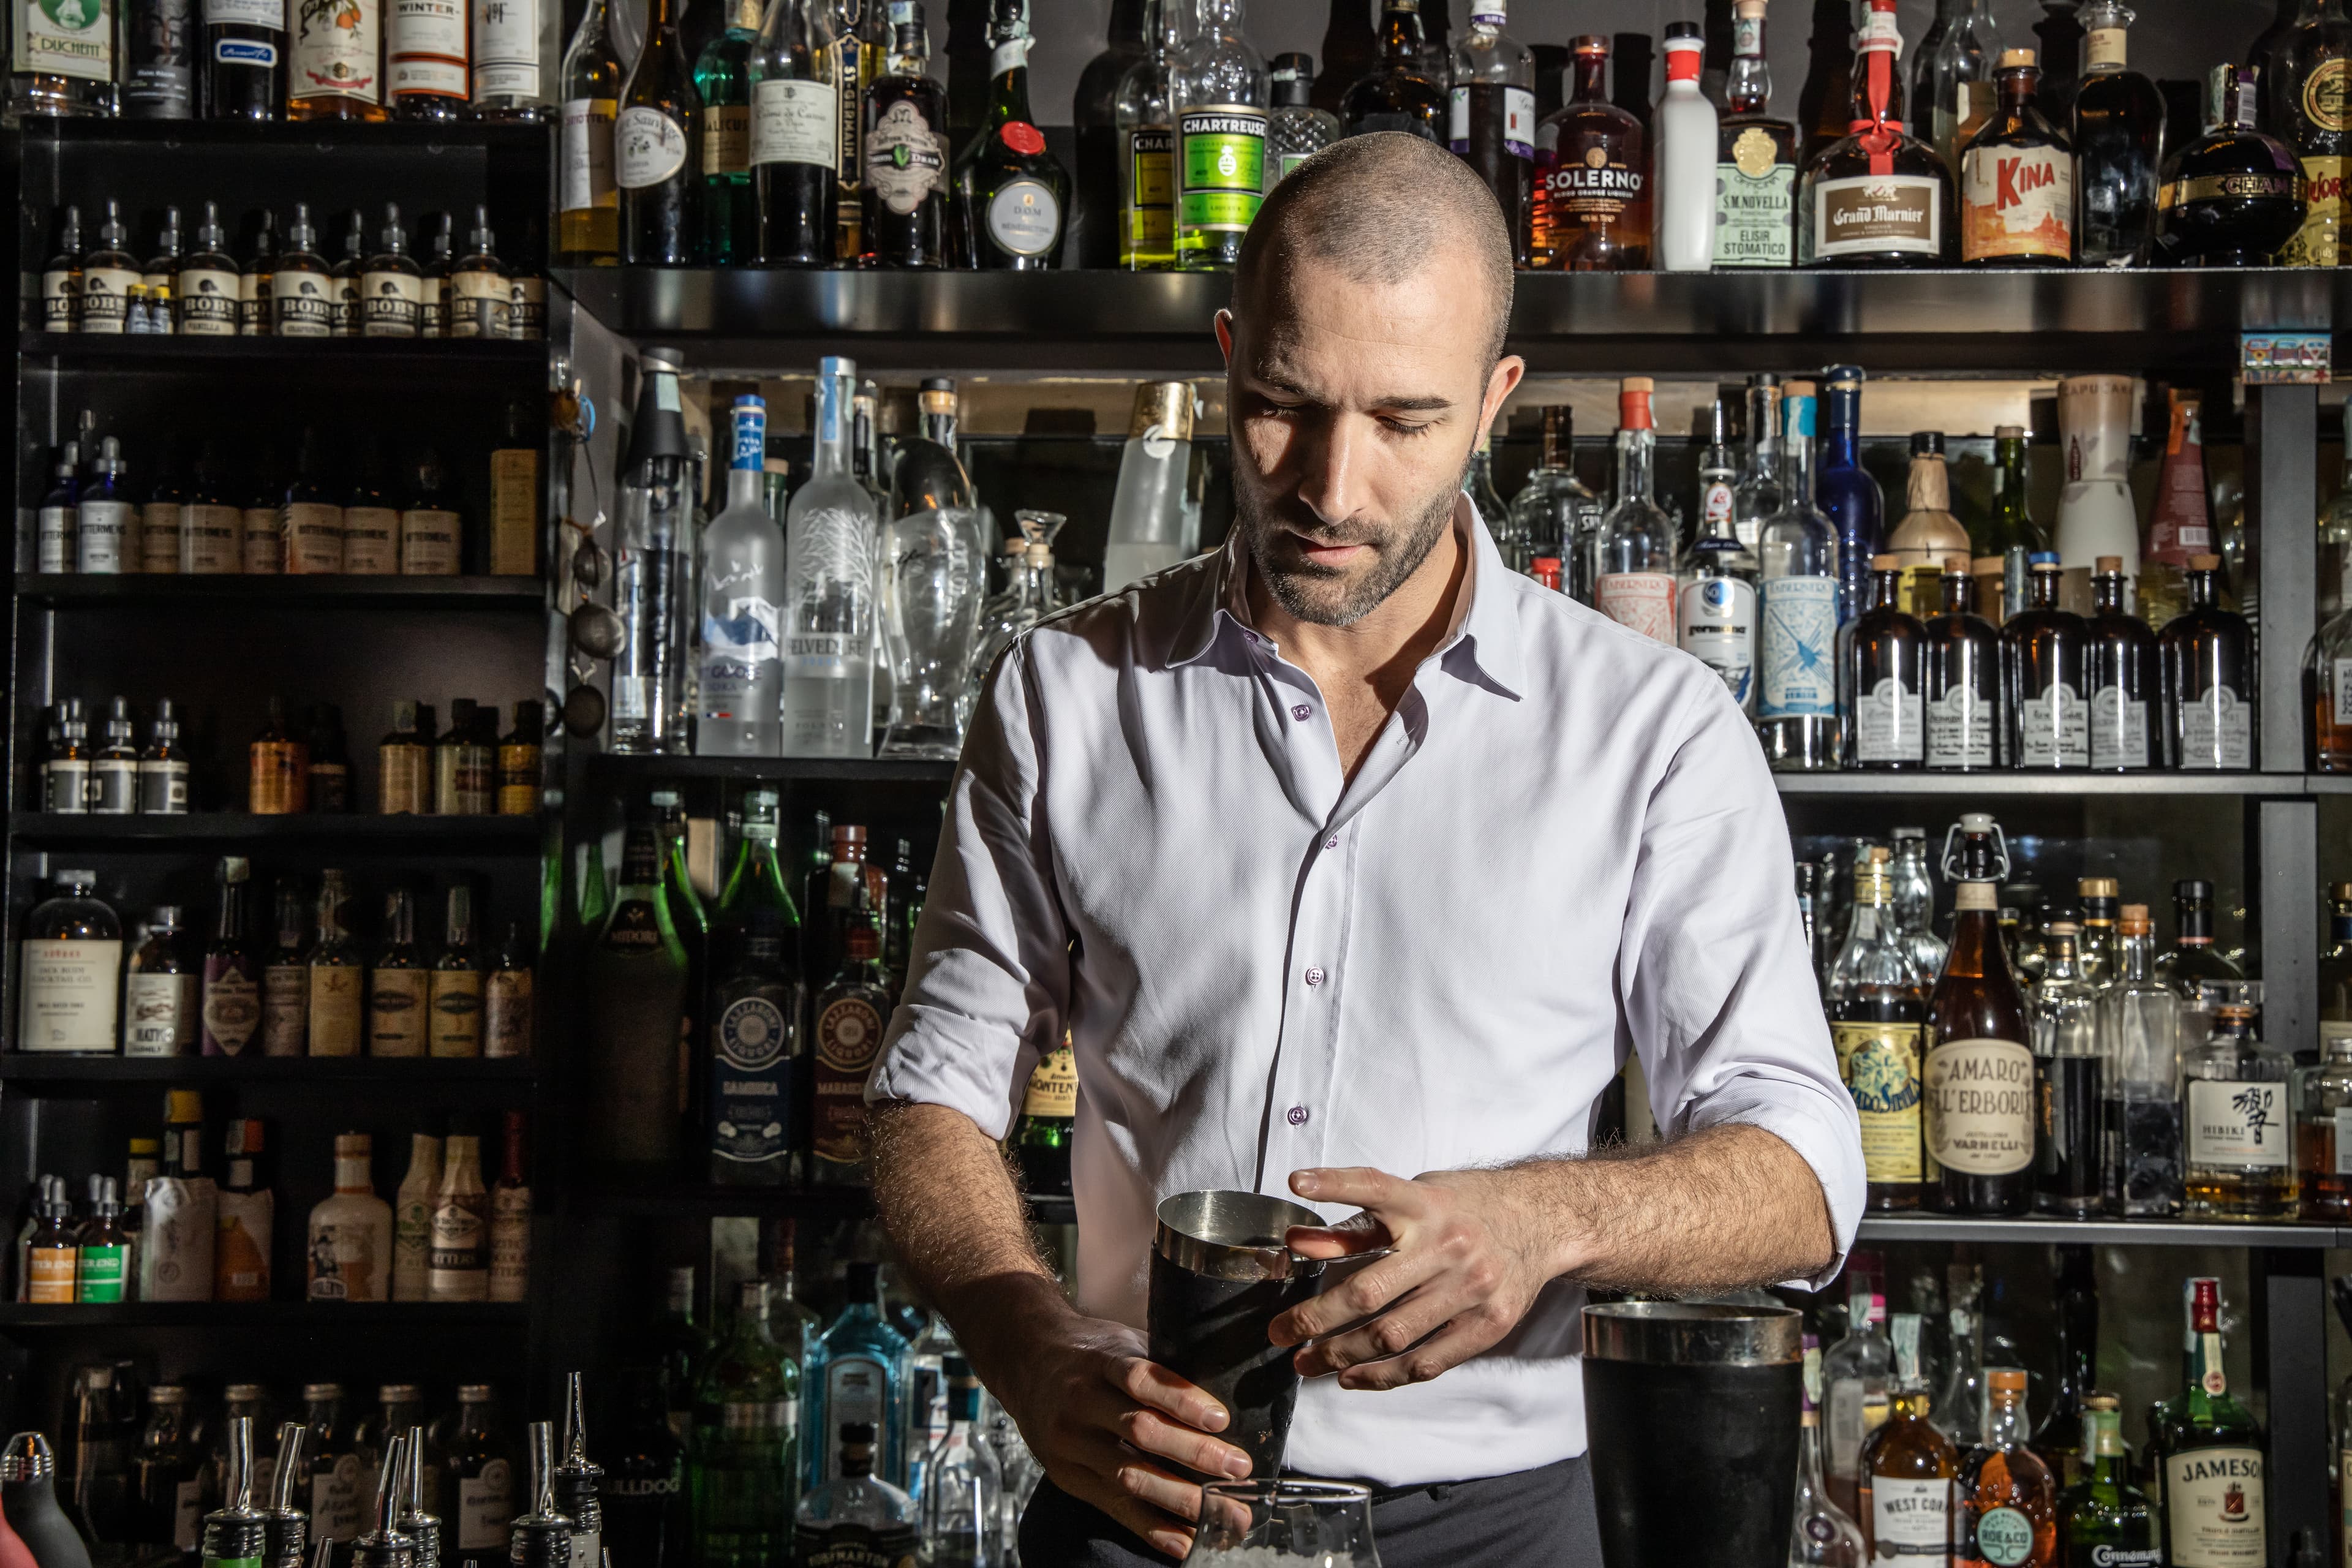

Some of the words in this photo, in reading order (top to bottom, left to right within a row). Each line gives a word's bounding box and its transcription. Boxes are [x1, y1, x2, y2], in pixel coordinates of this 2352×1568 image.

[1183, 118, 1266, 137] CHARTREUSE
[1545, 170, 1642, 191] SOLERNO
[1833, 206, 1872, 227] Grand
[1872, 205, 1923, 223] Marnier
[1724, 243, 1785, 255] STOMATICO
[1948, 1057, 2021, 1084] AMARO
[2203, 1125, 2245, 1136] HIBIKI
[1883, 1497, 1917, 1514] WEST
